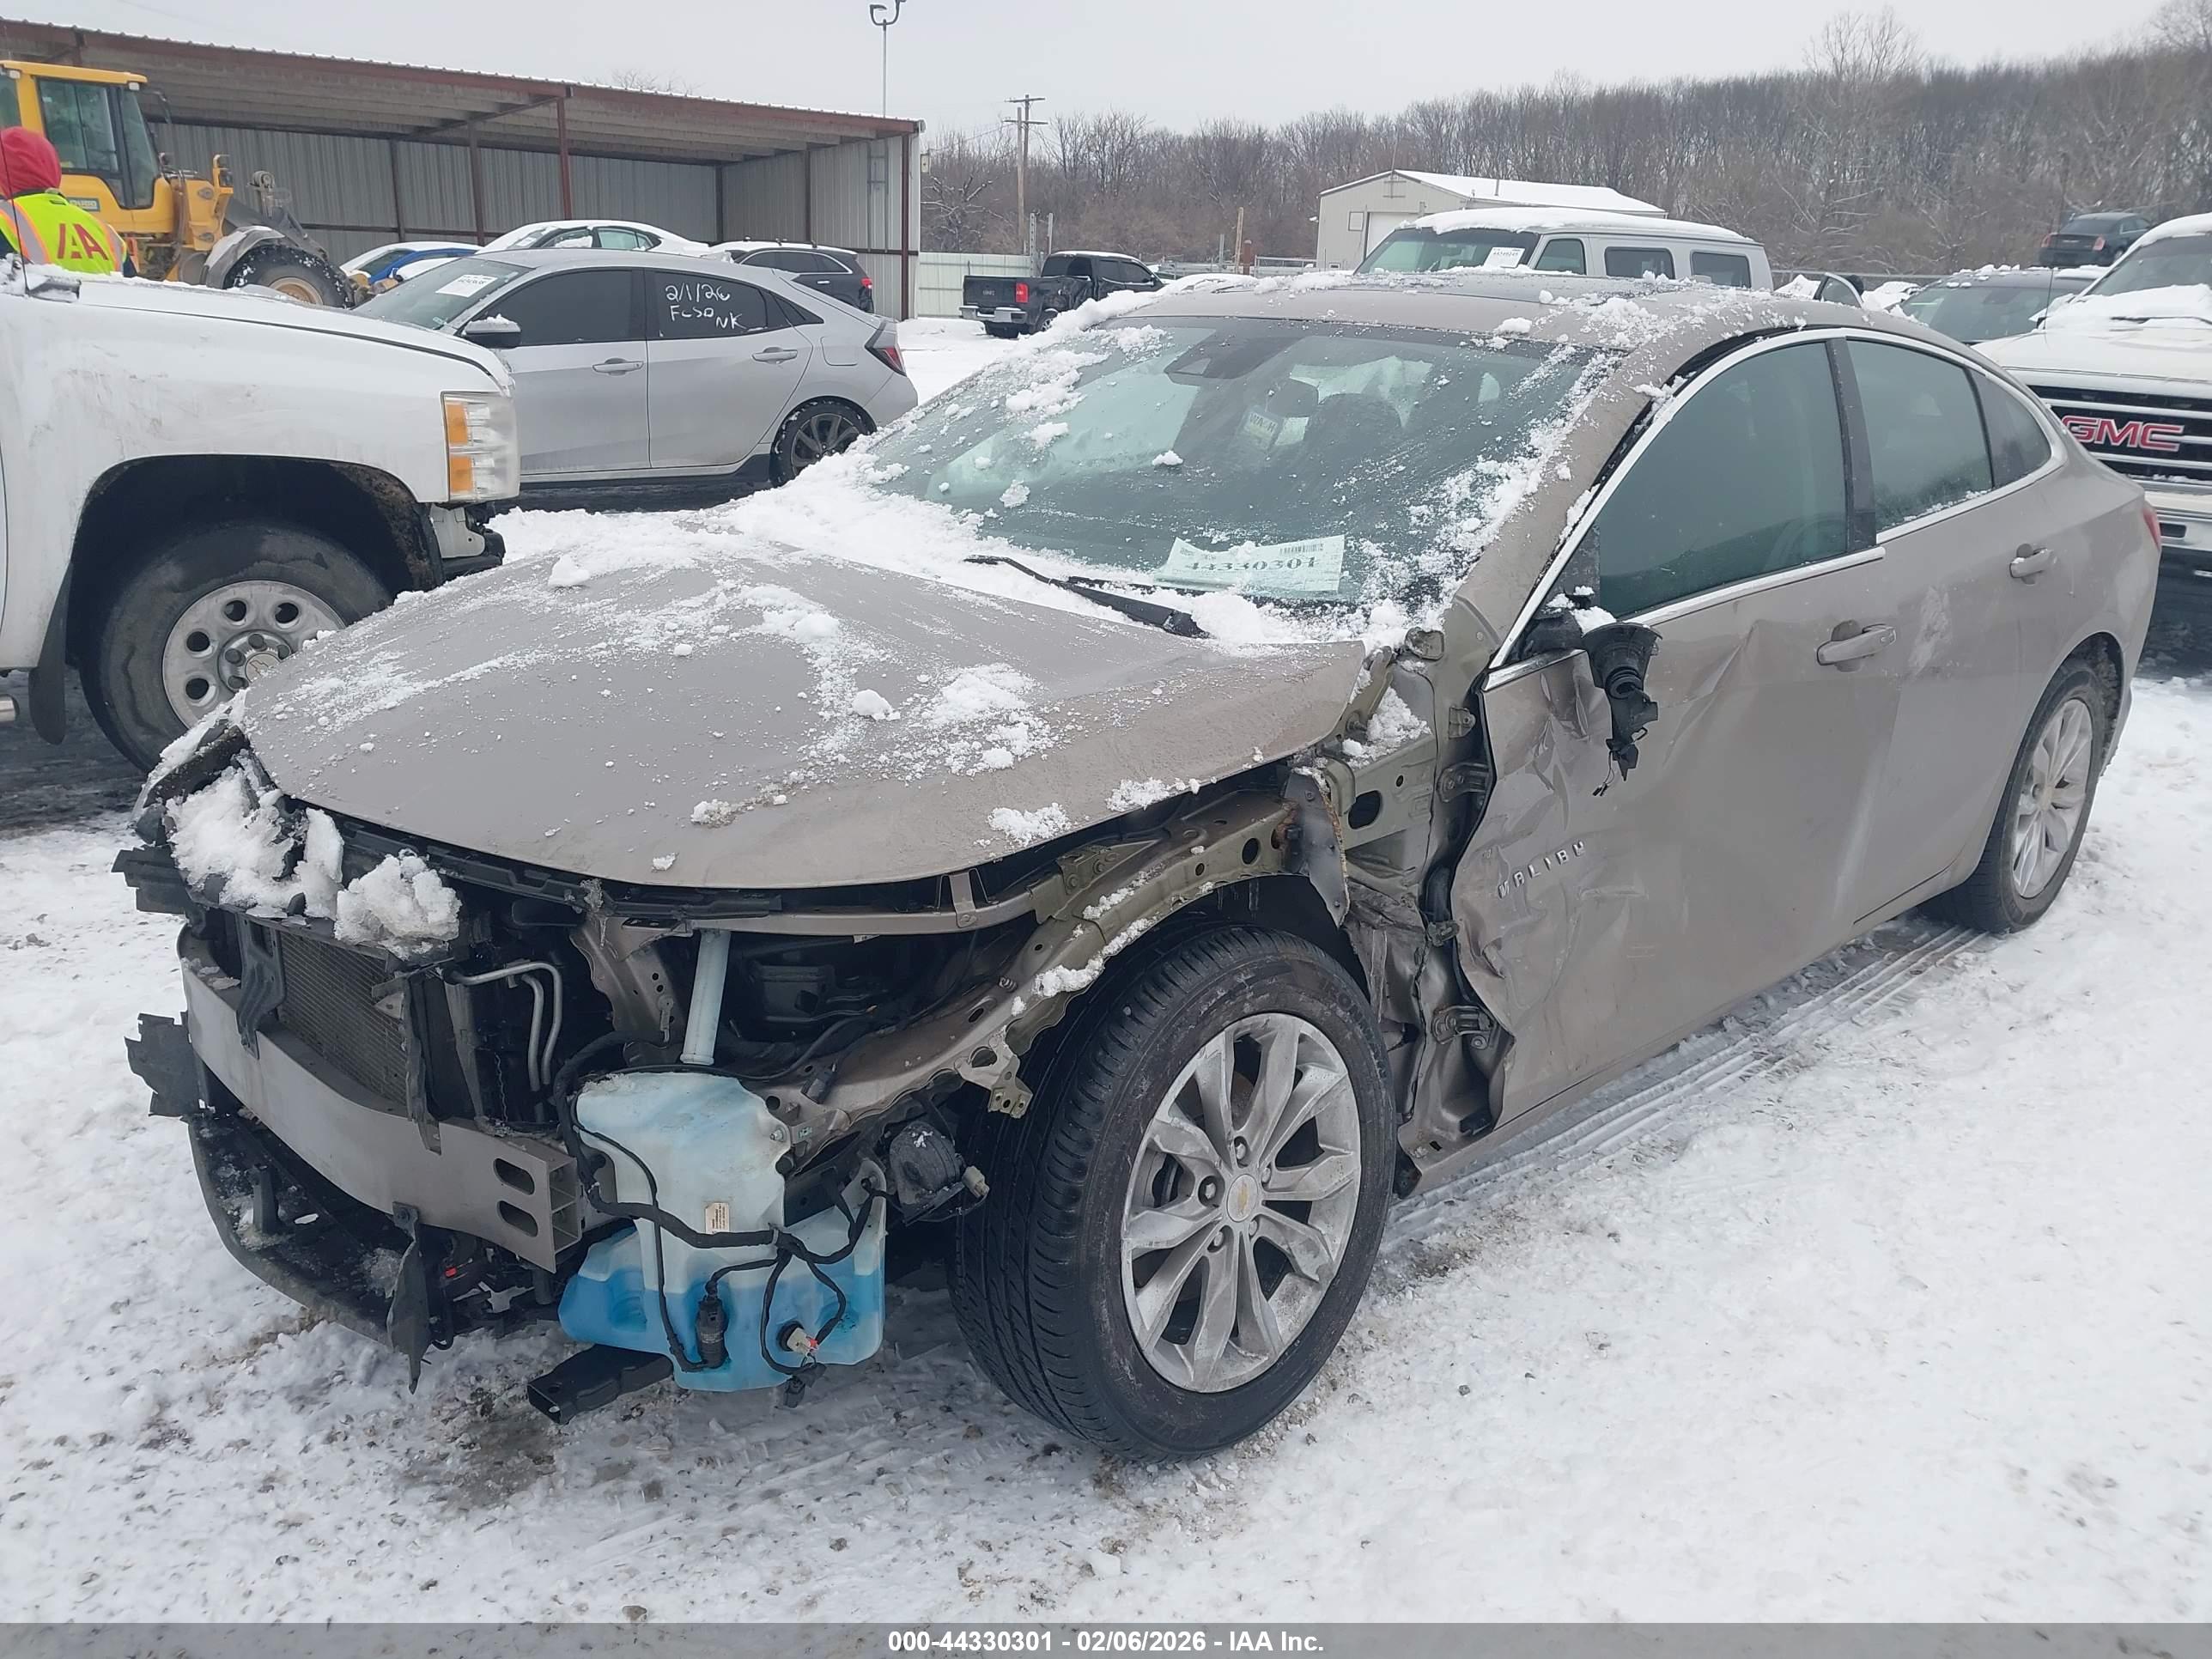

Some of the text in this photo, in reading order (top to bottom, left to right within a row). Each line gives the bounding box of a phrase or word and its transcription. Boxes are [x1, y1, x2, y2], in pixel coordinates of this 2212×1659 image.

[57, 222, 109, 261] IAA
[715, 312, 748, 330] NK
[2062, 415, 2185, 453] GMC
[1498, 840, 1585, 900] MALIBU
